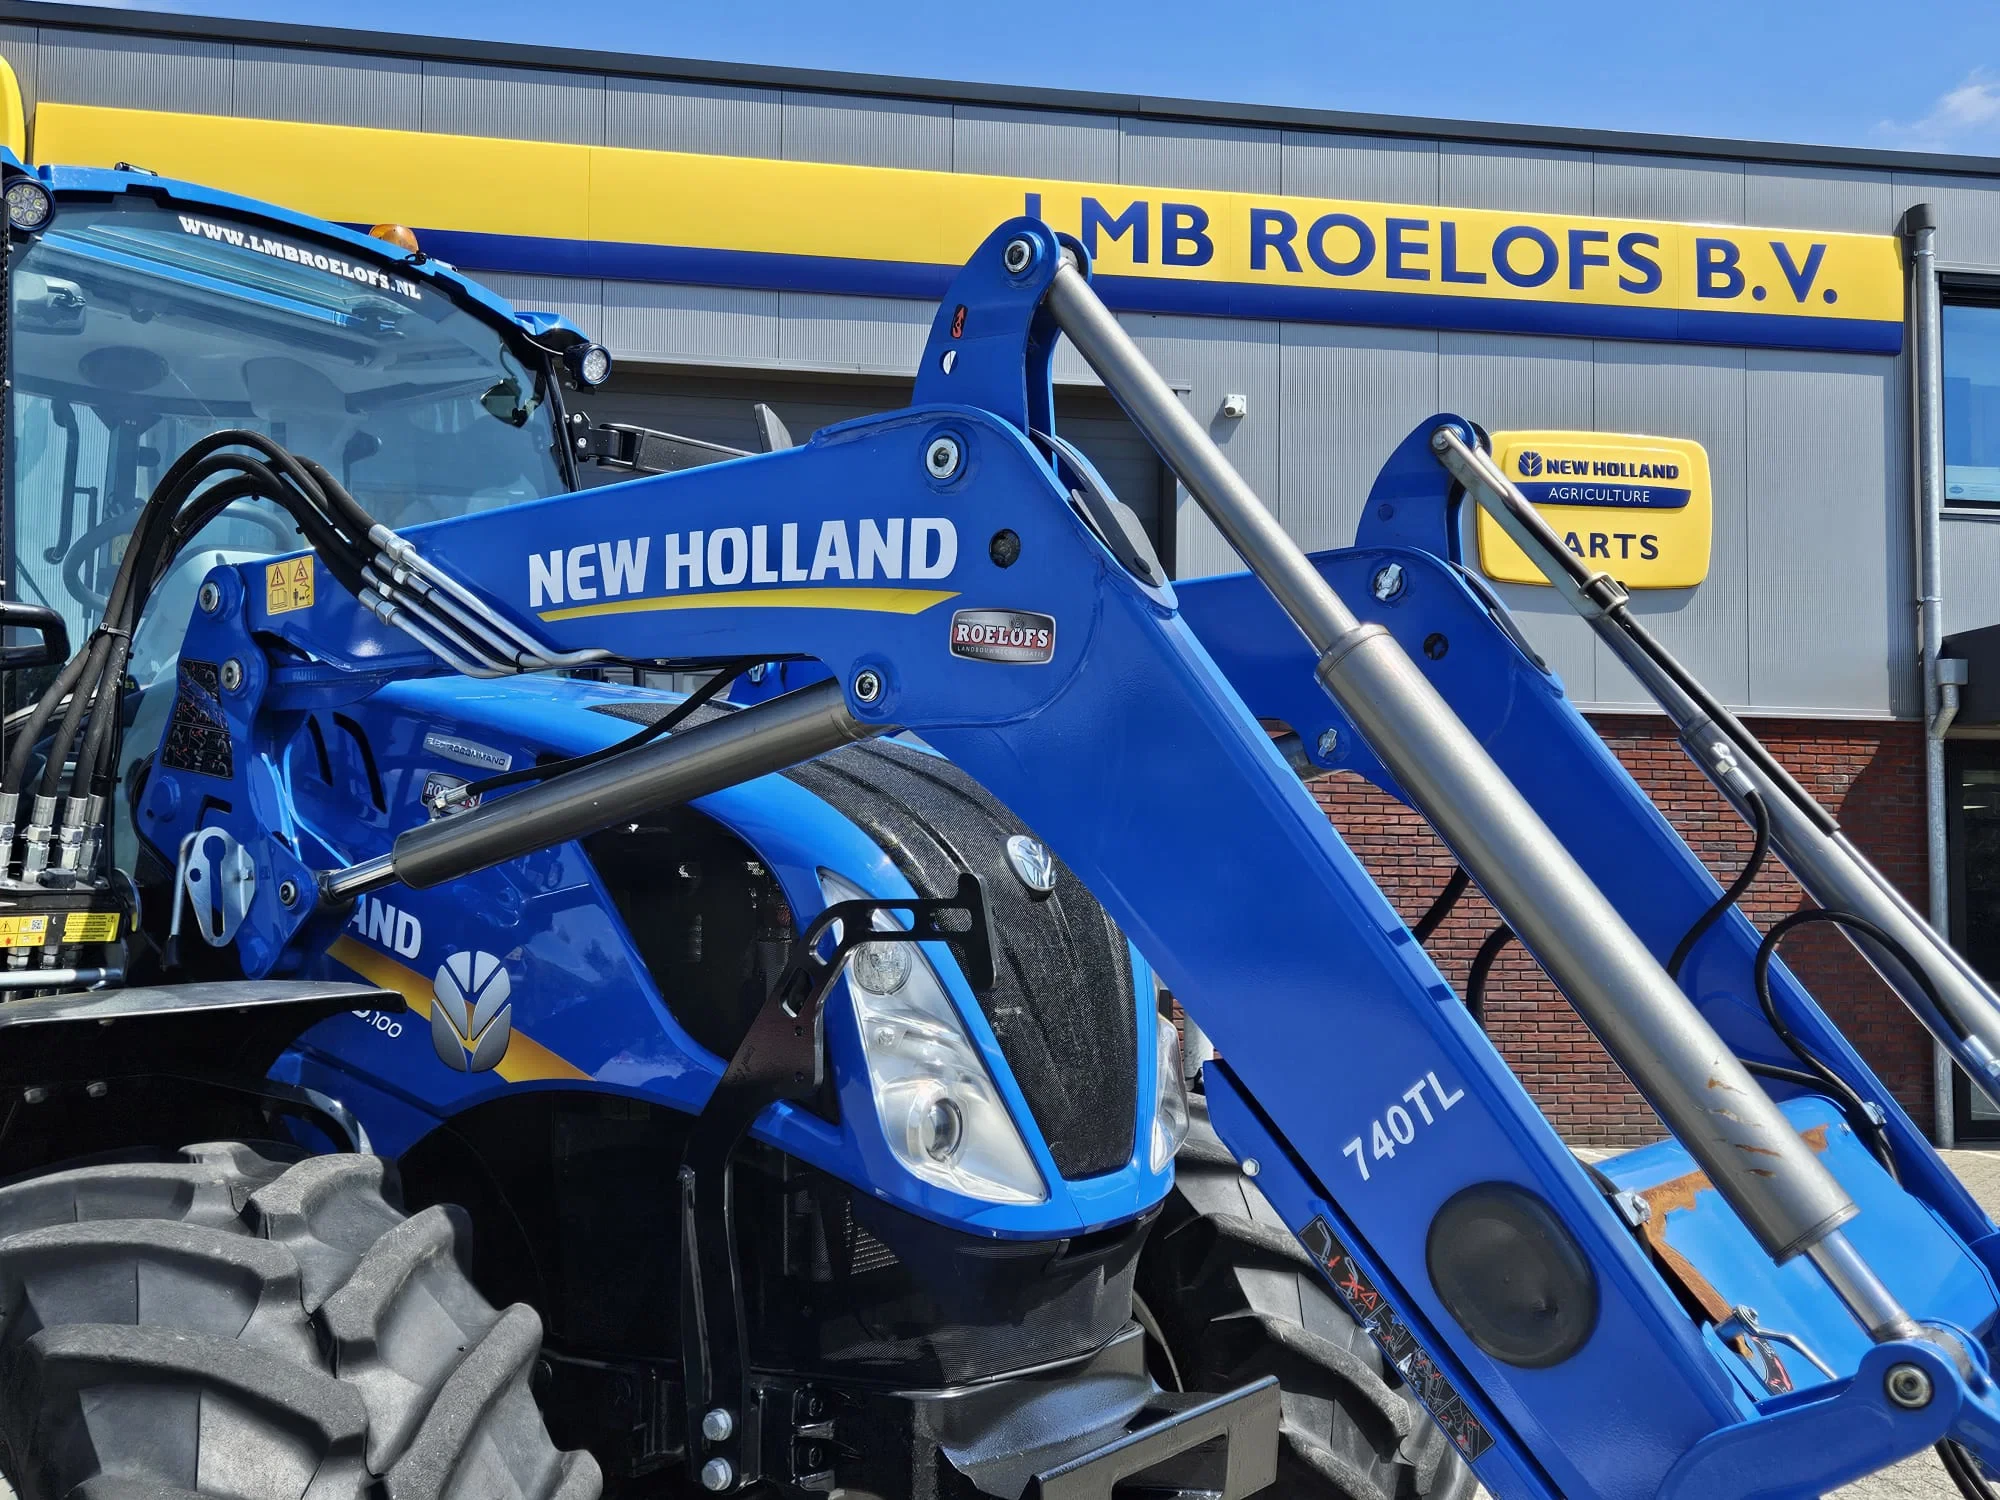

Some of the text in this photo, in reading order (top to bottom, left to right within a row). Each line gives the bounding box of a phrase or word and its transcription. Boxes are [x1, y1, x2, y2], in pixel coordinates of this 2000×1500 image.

[178, 215, 421, 299] WWW.LMBROELOFS.NL
[1250, 207, 1662, 294] ROELOFS
[1695, 237, 1838, 304] B.V.
[1546, 459, 1679, 479] NEW HOLLAND
[1548, 487, 1650, 503] AGRICULTURE
[528, 517, 958, 608] NEW HOLLAND
[1564, 531, 1659, 560] ARTS
[1342, 1071, 1464, 1181] 740TL
